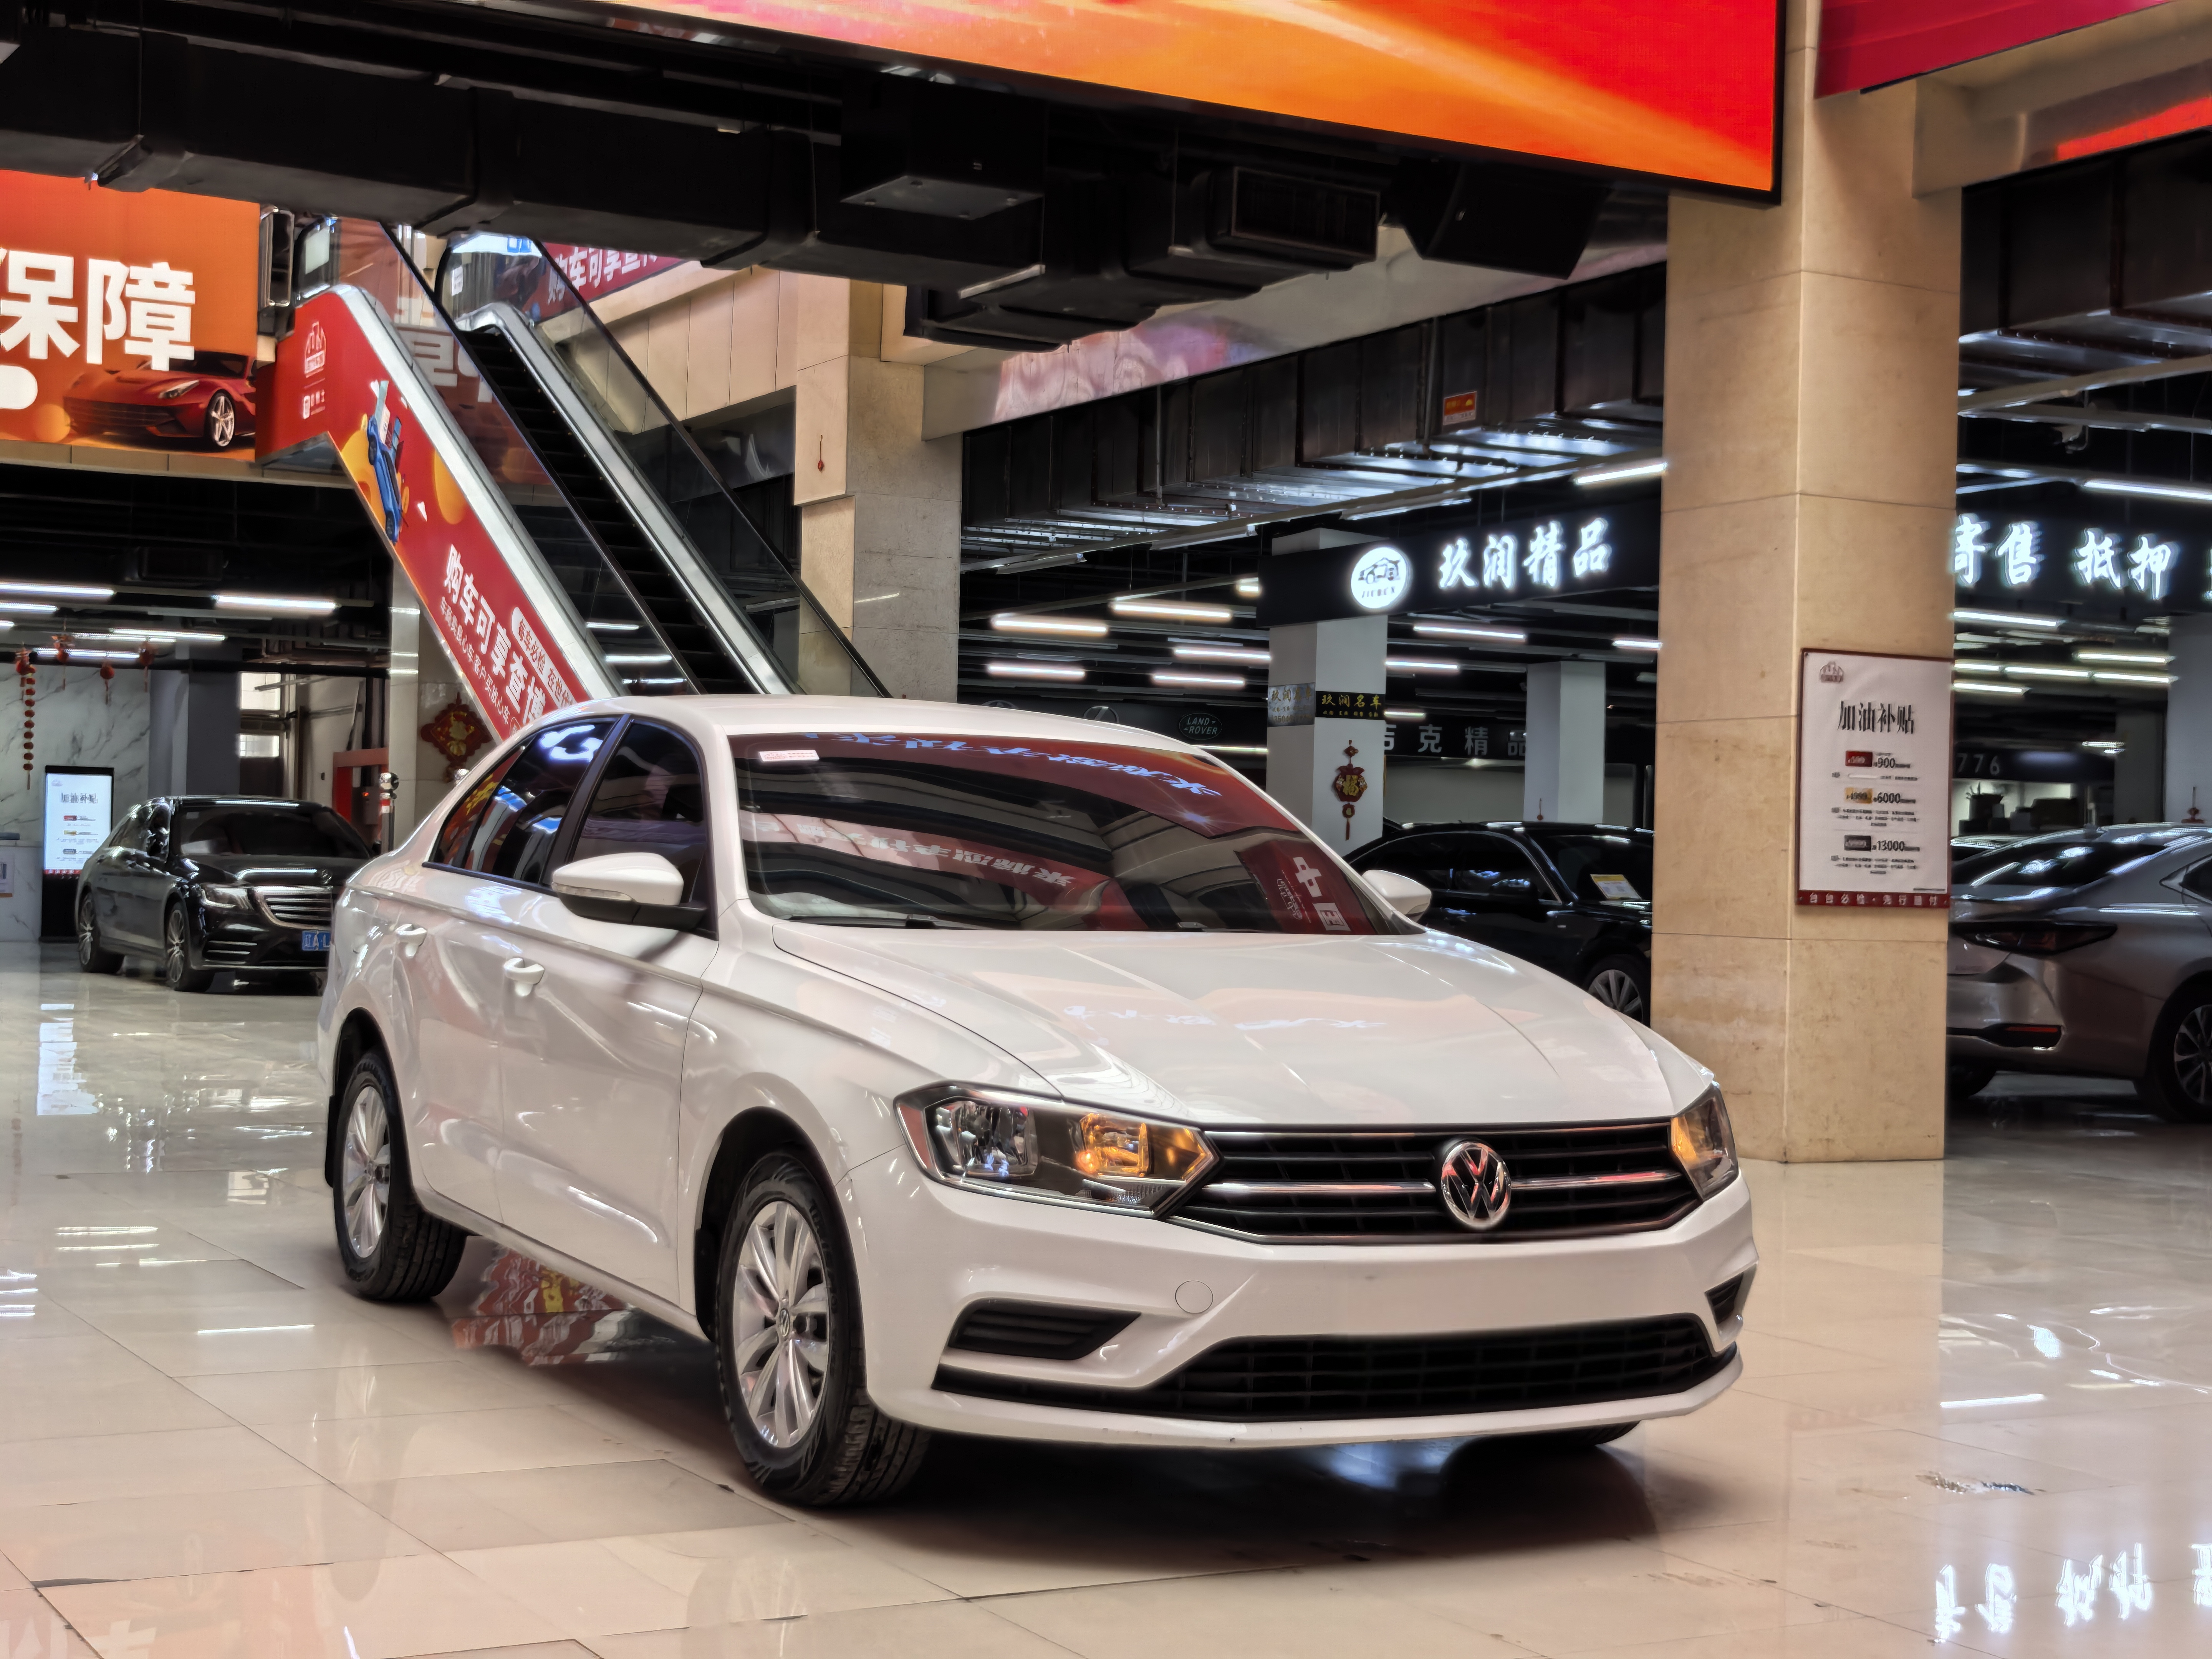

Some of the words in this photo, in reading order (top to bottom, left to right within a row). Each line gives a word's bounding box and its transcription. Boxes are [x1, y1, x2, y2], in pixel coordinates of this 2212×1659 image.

[0, 248, 195, 371] 保障
[2075, 528, 2179, 600] 抵押
[1187, 717, 1210, 725] LAND
[1189, 726, 1218, 734] ROVER
[1837, 700, 1914, 734] 加油补贴
